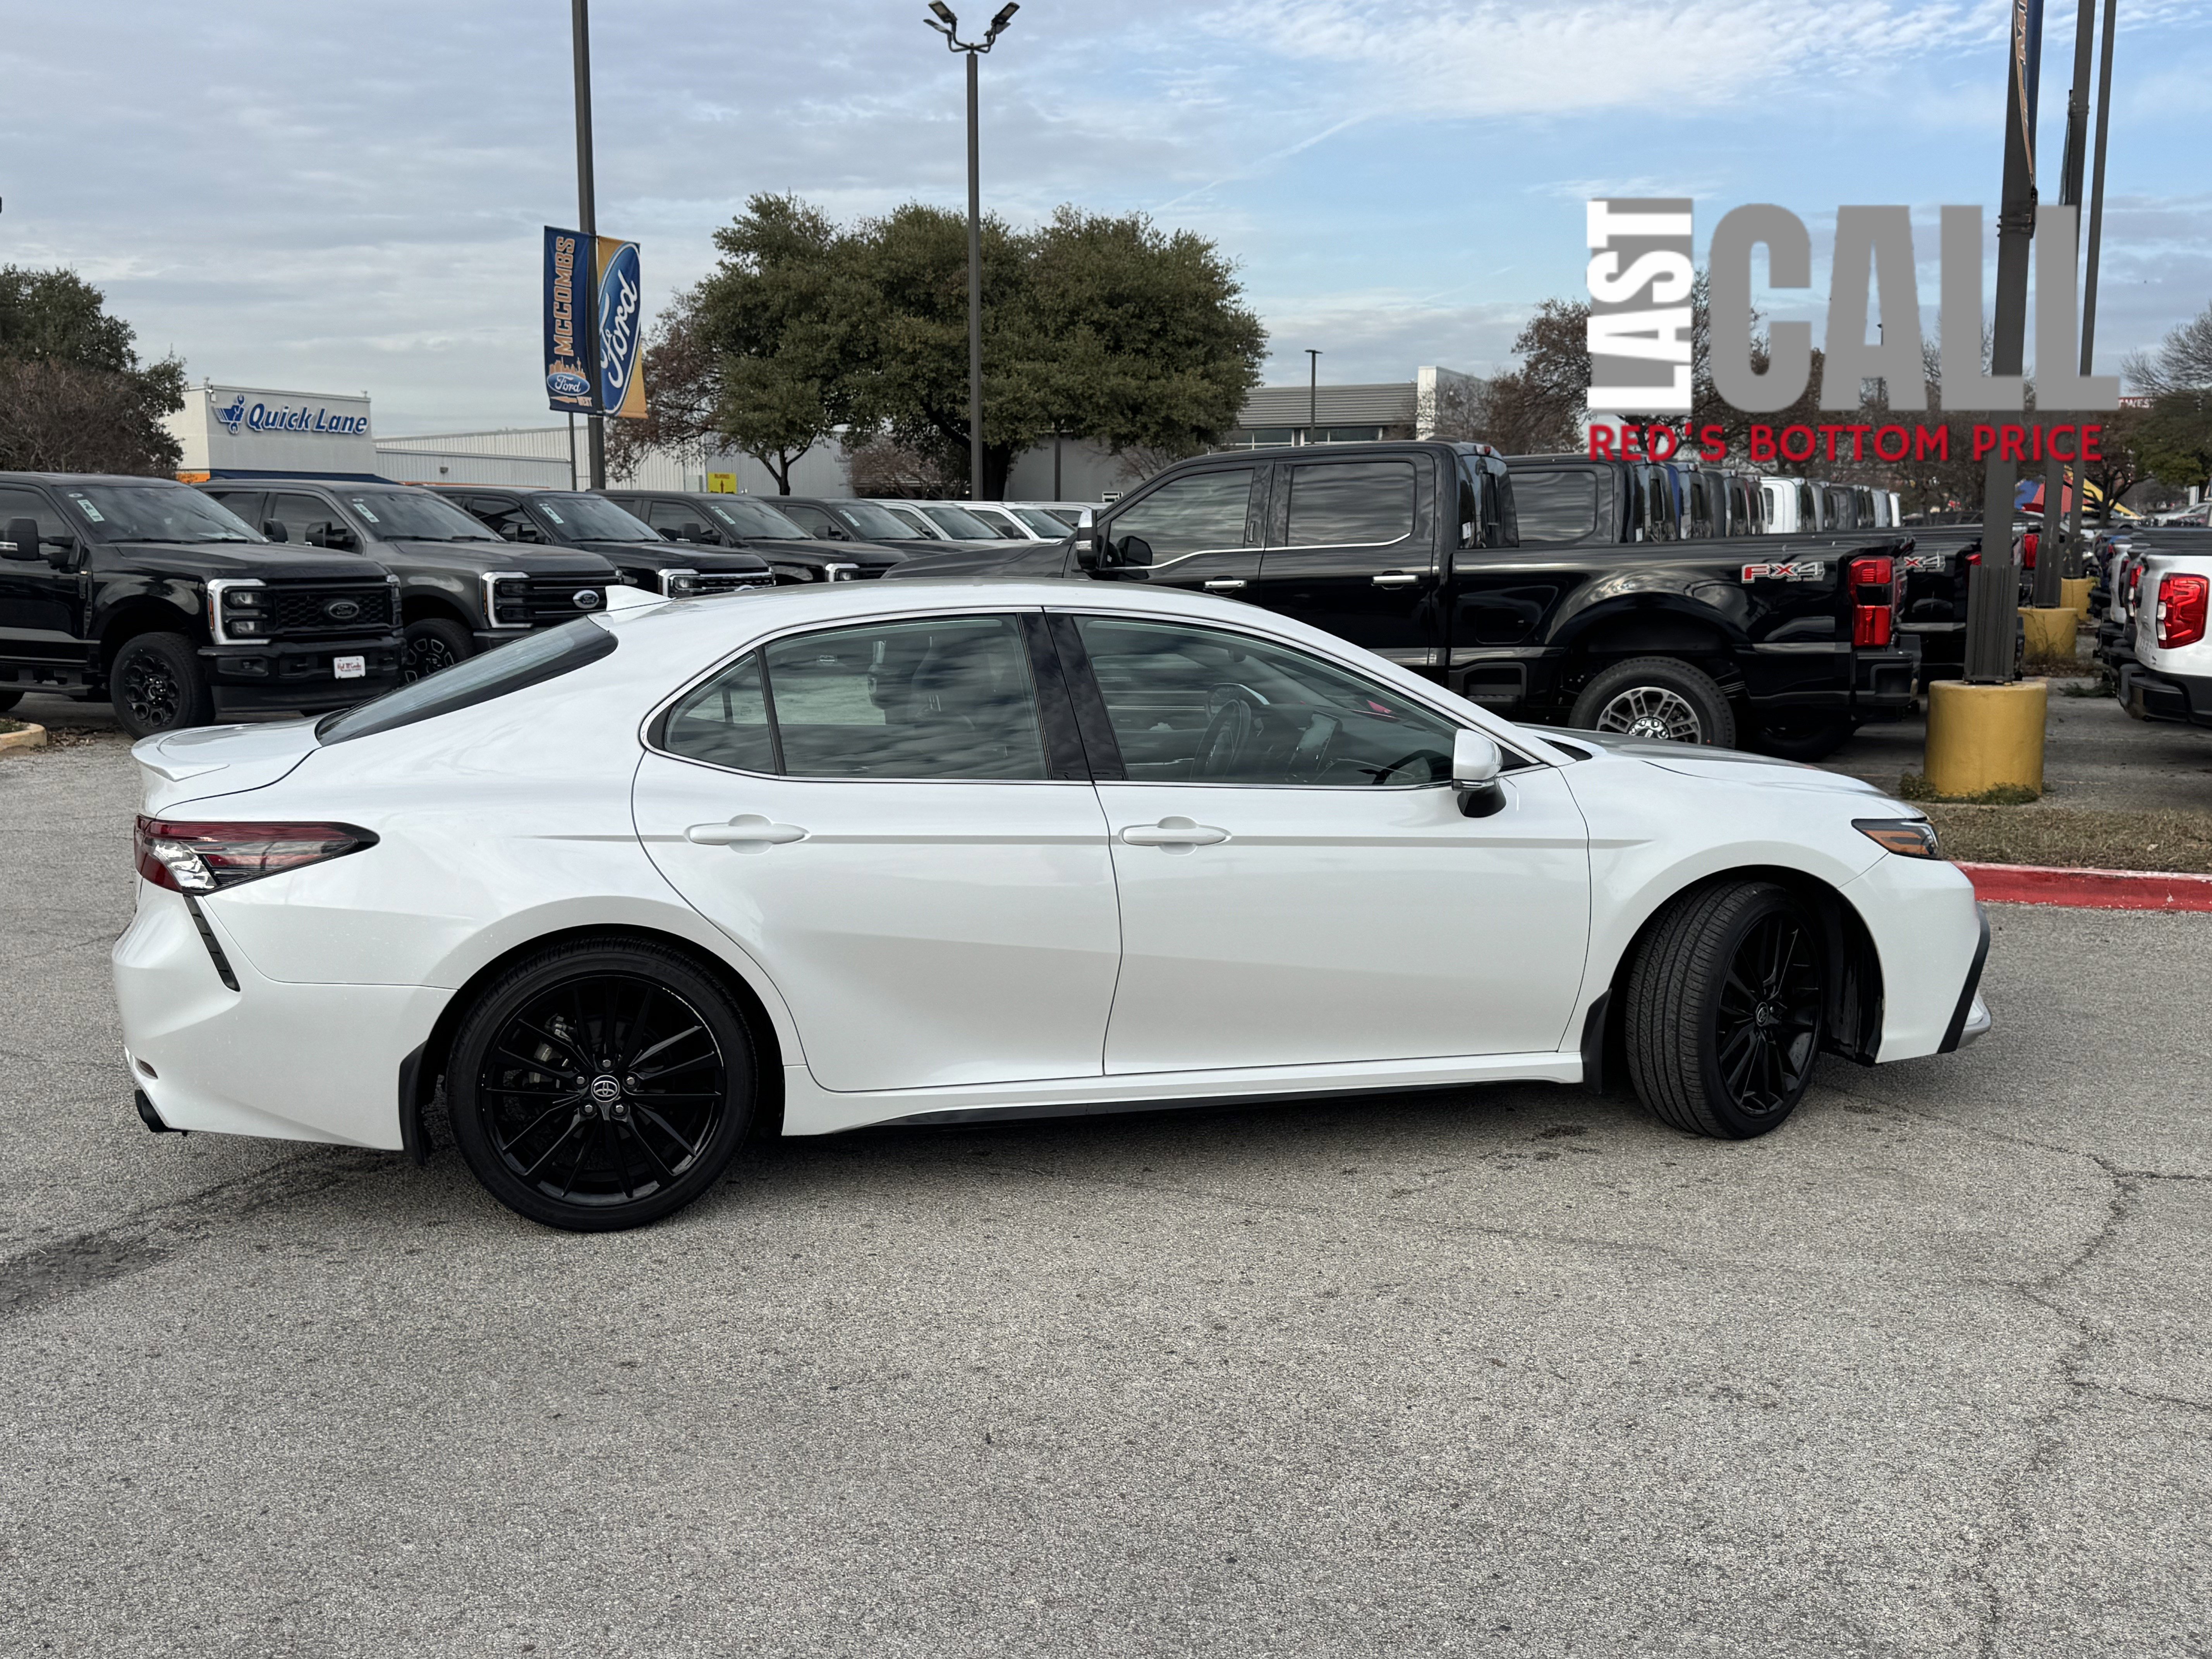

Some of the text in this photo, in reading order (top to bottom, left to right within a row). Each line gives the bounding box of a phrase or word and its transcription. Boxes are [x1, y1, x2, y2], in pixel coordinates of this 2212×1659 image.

[553, 236, 575, 356] MCCOMBS
[600, 270, 637, 388] Ford
[555, 376, 581, 392] Ford
[248, 403, 368, 434] Quick Lane
[1741, 562, 1825, 584] FX4
[1903, 556, 1946, 568] X4
